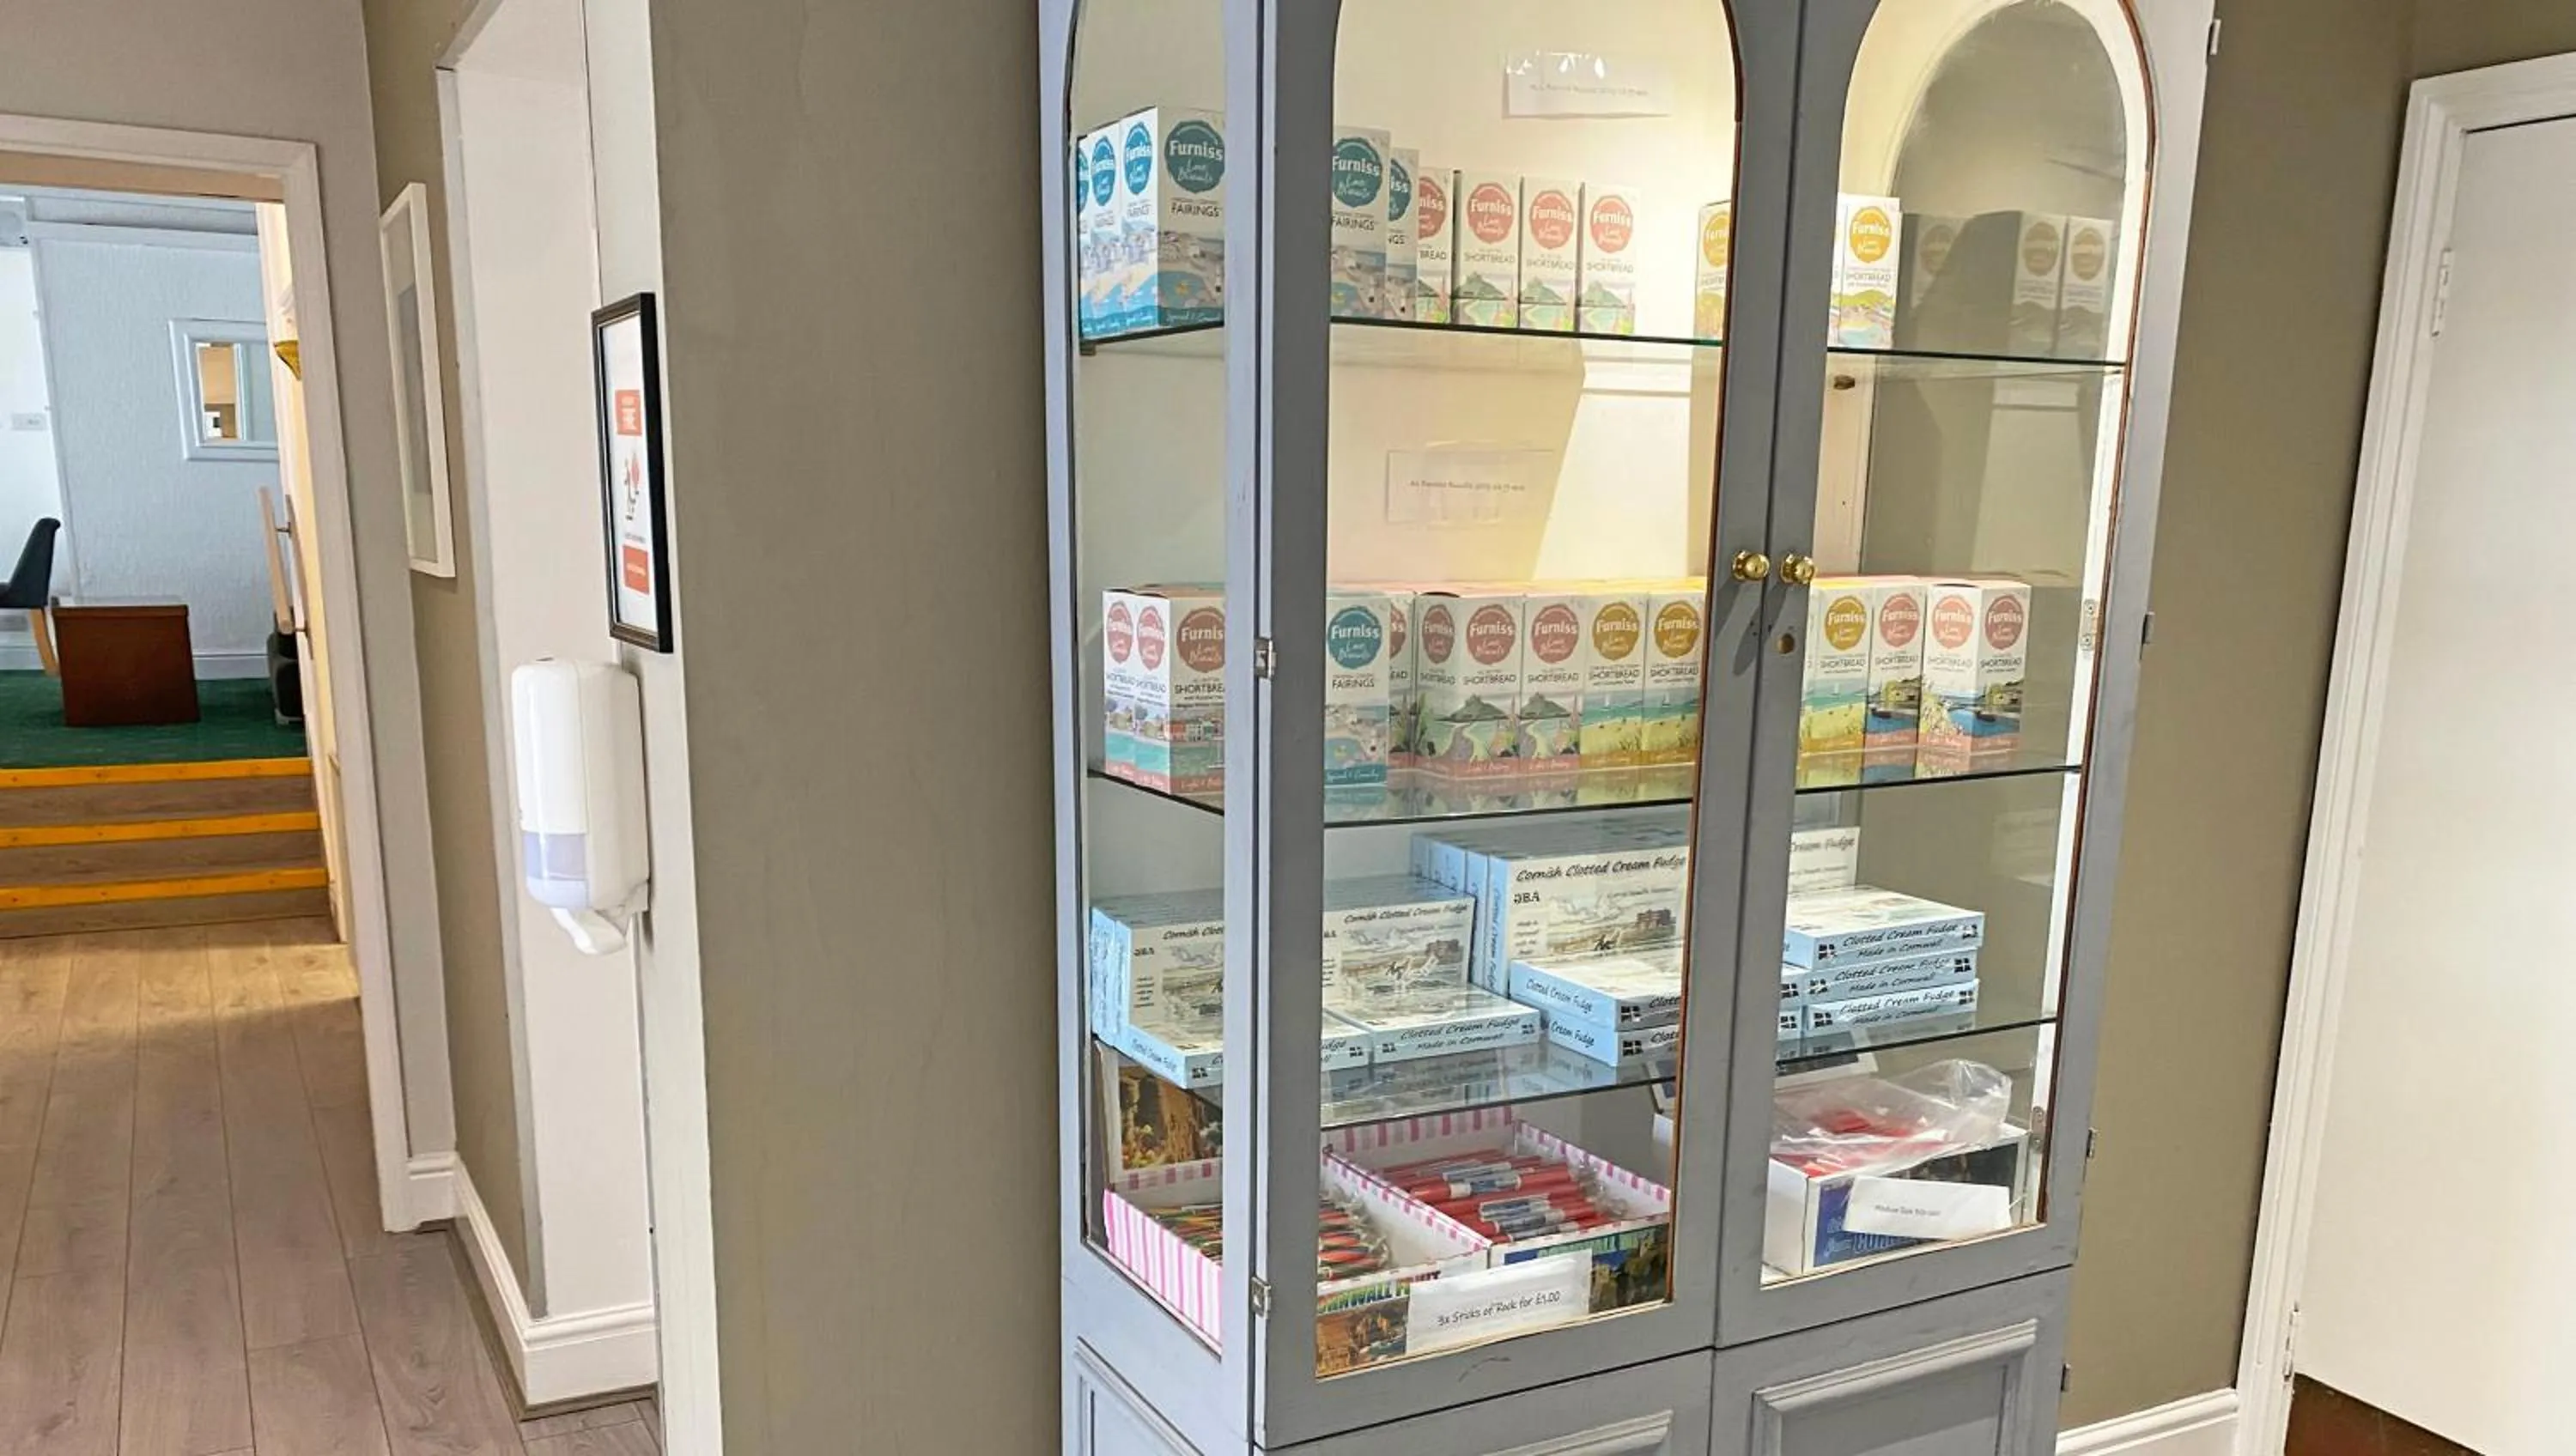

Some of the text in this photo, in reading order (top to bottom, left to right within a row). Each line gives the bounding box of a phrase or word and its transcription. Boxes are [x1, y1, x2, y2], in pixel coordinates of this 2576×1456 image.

[1169, 140, 1224, 161] Furniss
[1332, 155, 1380, 177] Furniss
[1170, 202, 1220, 218] FAIRINGS
[1471, 199, 1512, 215] Furniss
[1827, 610, 1865, 626] Furniss
[1881, 607, 1918, 622] Furniss
[1935, 609, 1972, 624] Furniss
[1988, 610, 2022, 624] Furniss
[1332, 624, 1380, 640] Furniss
[1469, 621, 1515, 637] Furniss
[1534, 620, 1577, 636] Furniss
[1596, 617, 1638, 633] Furniss
[1658, 616, 1698, 632] Furniss
[1181, 627, 1224, 643] Furnis
[1175, 683, 1224, 695] SHORTBRE
[1516, 867, 1563, 883] Cornish
[1565, 860, 1610, 878] Clotted
[1613, 859, 1650, 874] Cream
[1843, 922, 1959, 947] Clotted Cream Fudge
[1835, 966, 1878, 981] Clotted
[1879, 963, 1916, 975] Cream
[1840, 998, 1881, 1014] Clotted
[1884, 996, 1920, 1007] Cream
[1400, 1024, 1444, 1041] Clotted
[1445, 1021, 1484, 1034] Cream
[1452, 1307, 1481, 1324] Sticks
[1483, 1307, 1493, 1317] of
[1496, 1300, 1517, 1313] Rock
[1519, 1295, 1534, 1309] for
